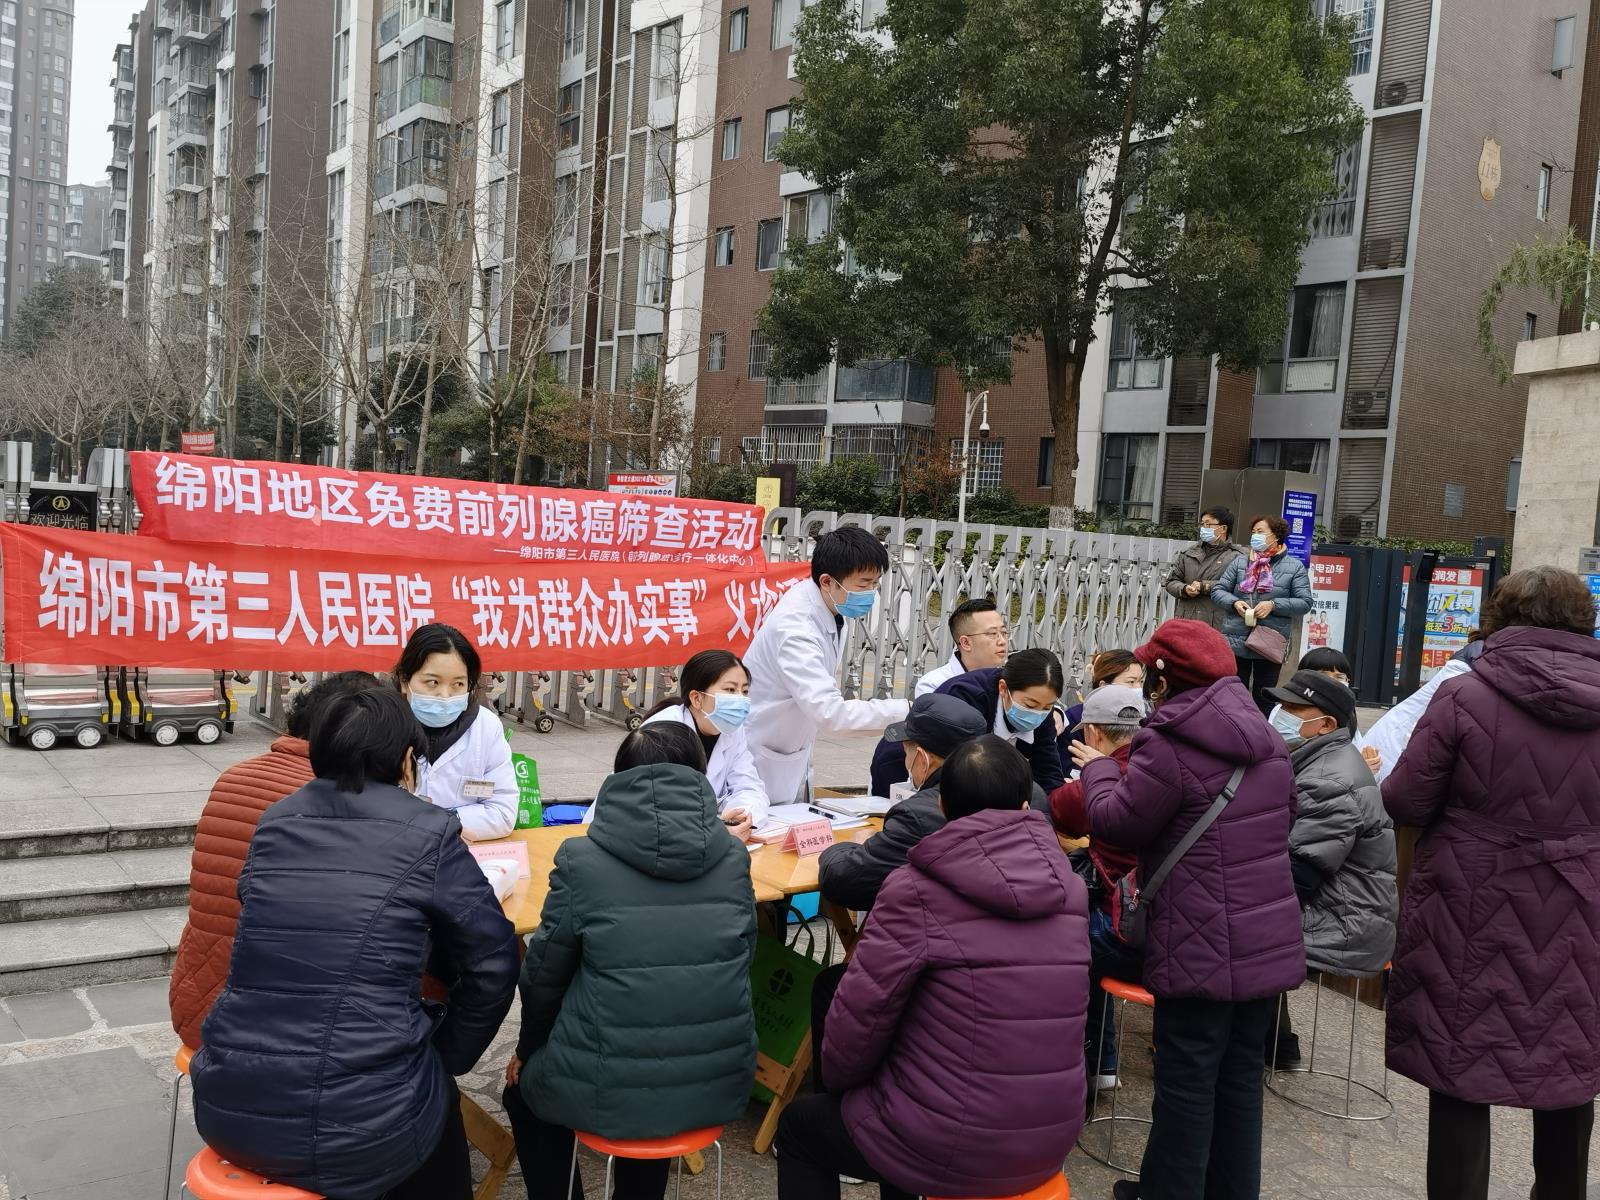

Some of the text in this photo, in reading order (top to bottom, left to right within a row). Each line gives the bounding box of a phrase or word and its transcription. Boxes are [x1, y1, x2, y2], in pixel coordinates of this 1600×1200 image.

[155, 456, 758, 549] 绵阳地区免费前列腺癌筛查活动
[31, 513, 89, 530] 欢迎光临
[1432, 570, 1457, 582] 润发
[38, 549, 435, 649] 绵阳市第三人民医院
[452, 575, 706, 649] “我为群众办实事”
[1303, 687, 1315, 698] N
[799, 834, 833, 849] 全科医学科
